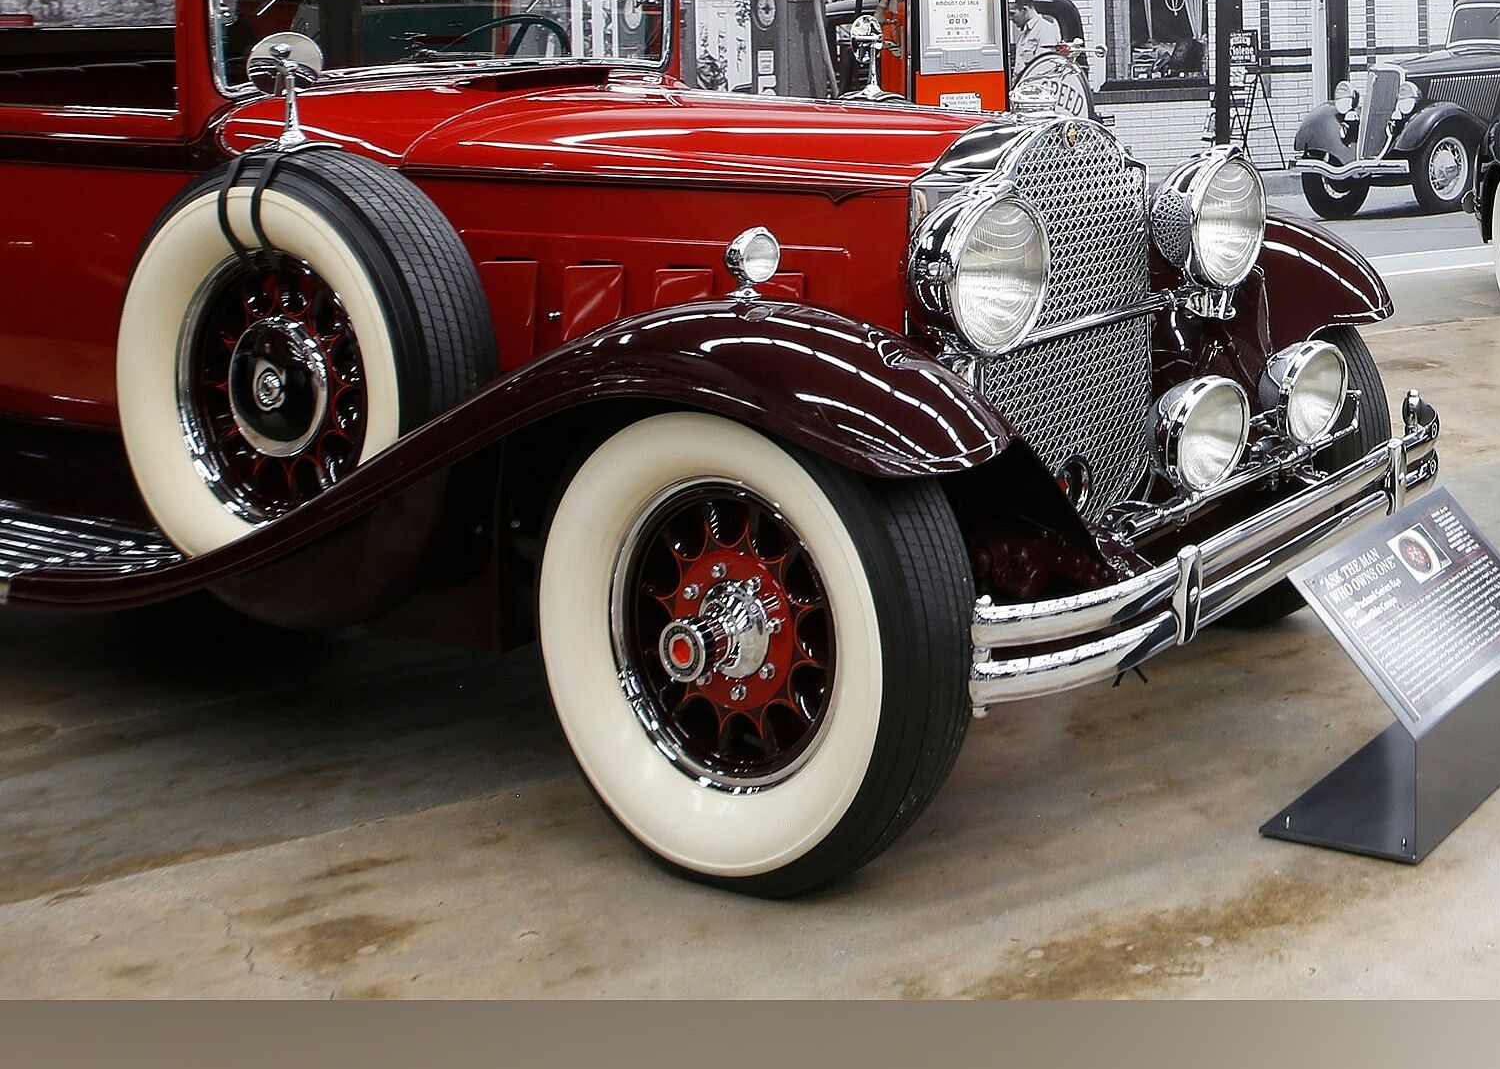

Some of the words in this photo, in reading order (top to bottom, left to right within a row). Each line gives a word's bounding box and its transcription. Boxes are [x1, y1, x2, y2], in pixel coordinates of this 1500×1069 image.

[1319, 569, 1345, 591] "ASK
[1340, 559, 1362, 580] THE
[1359, 547, 1381, 569] MAN
[1329, 582, 1354, 604] WHO
[1351, 567, 1379, 592] OWNS
[1375, 554, 1397, 576] ONE"
